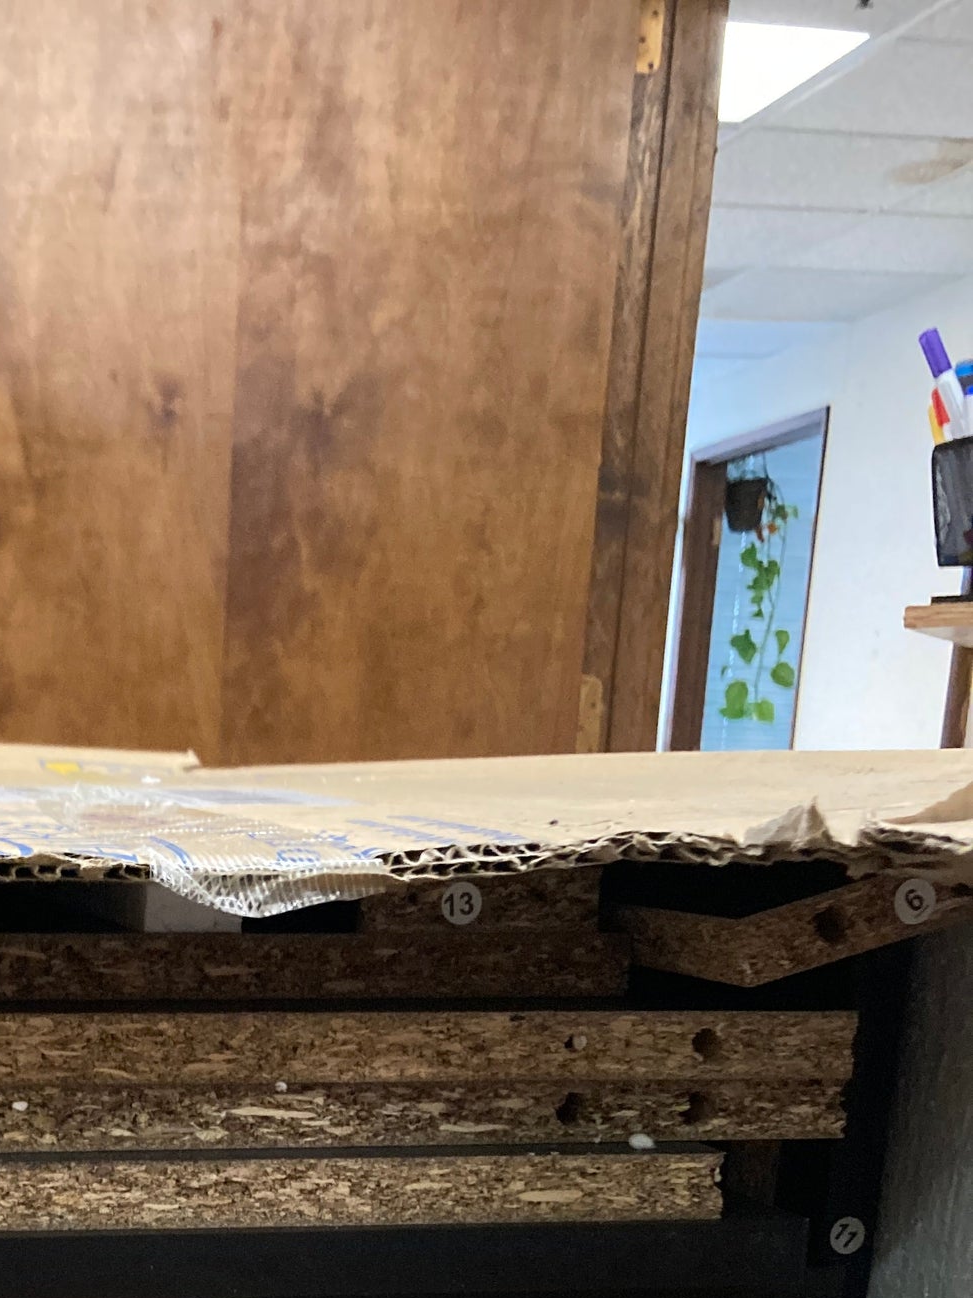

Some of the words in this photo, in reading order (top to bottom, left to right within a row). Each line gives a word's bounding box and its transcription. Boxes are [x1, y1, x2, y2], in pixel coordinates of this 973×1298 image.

[444, 891, 474, 917] 13
[904, 889, 925, 911] 6
[834, 1224, 858, 1248] 11
